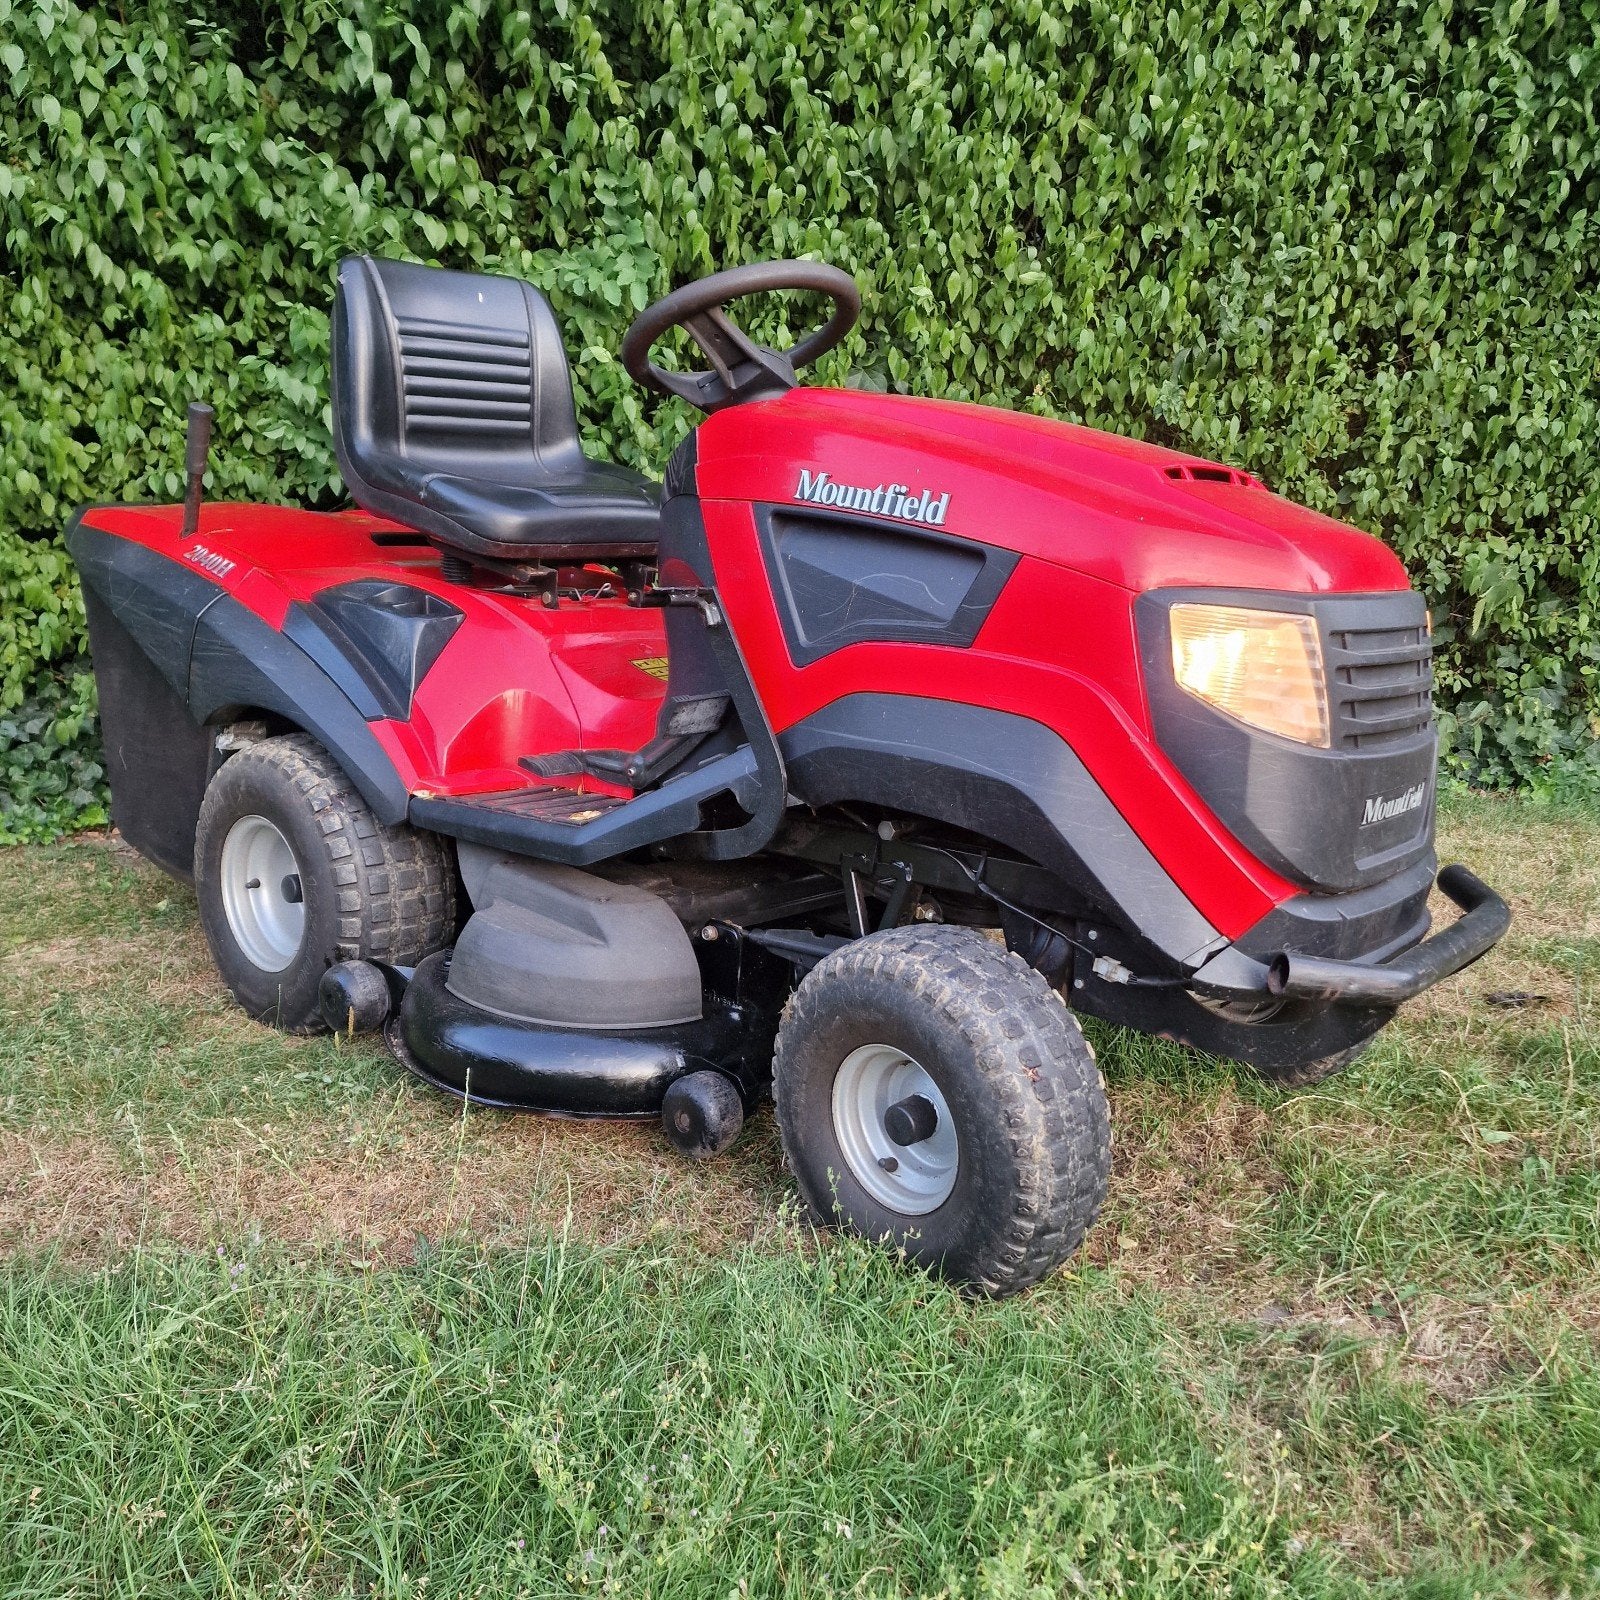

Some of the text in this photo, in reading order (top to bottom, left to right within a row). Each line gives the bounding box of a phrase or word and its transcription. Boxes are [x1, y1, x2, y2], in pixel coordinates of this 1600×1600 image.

[793, 468, 951, 526] Mountfield
[183, 544, 237, 579] 2040H
[1360, 781, 1426, 826] Mountfield
